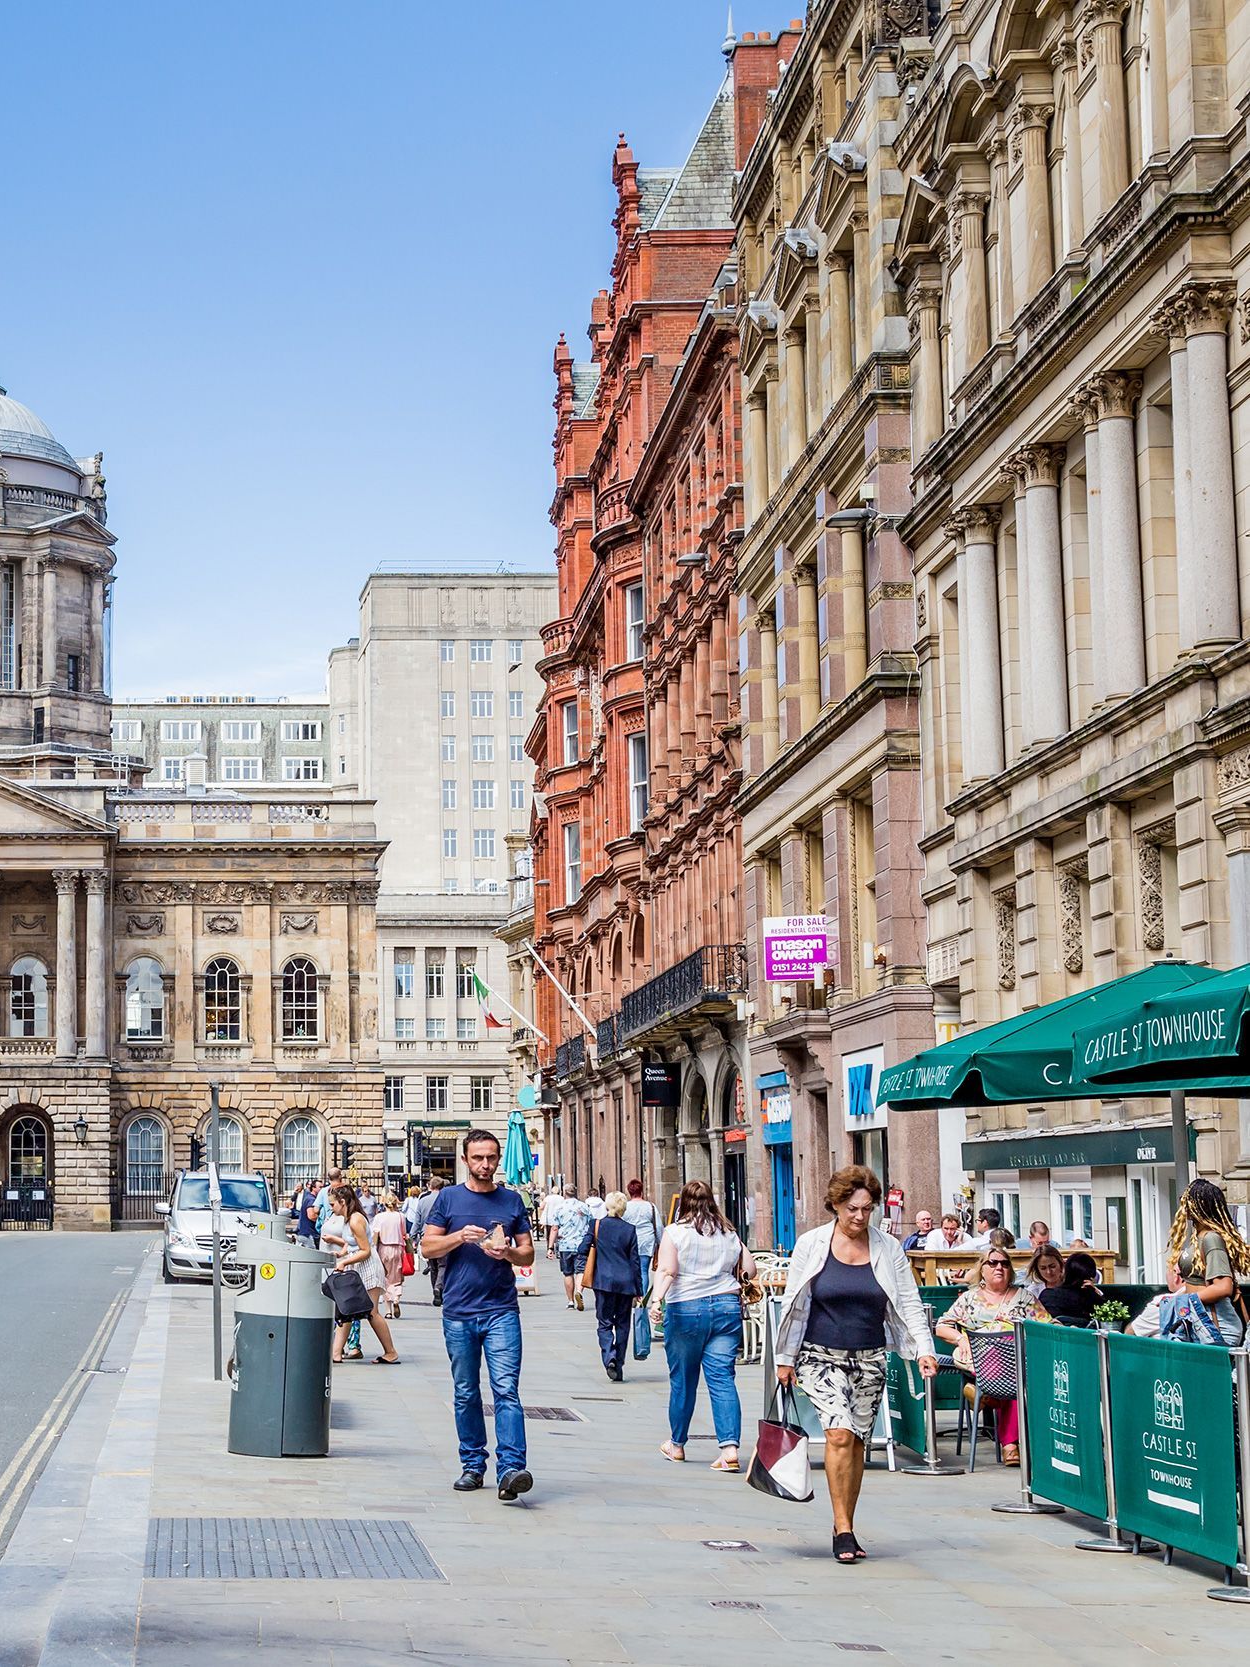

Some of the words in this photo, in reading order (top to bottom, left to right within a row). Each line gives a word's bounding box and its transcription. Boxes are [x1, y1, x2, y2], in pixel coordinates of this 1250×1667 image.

[787, 918, 804, 927] FOR
[806, 917, 826, 926] SALE
[771, 938, 823, 951] mason
[771, 949, 814, 961] owen
[772, 962, 791, 971] 0151
[792, 962, 807, 971] 242
[1085, 1028, 1128, 1065] CASTLE
[1132, 1022, 1143, 1053] ST
[1146, 1008, 1226, 1047] TOWNHOUSE
[645, 1067, 665, 1075] Queen
[1142, 1431, 1183, 1457] CASTLE
[1186, 1441, 1197, 1460] ST
[1150, 1468, 1192, 1489] TOWNHOUSE
